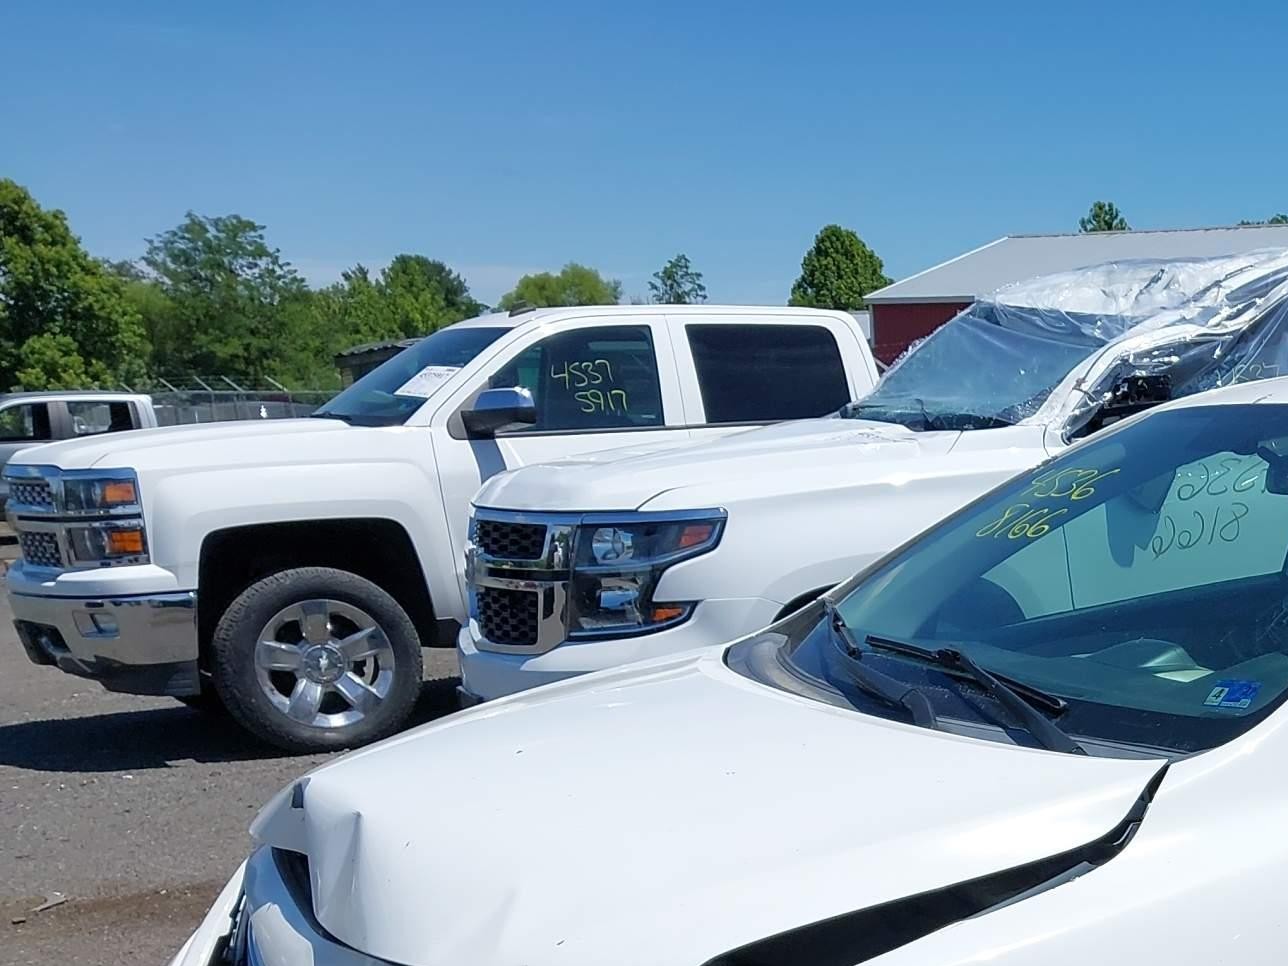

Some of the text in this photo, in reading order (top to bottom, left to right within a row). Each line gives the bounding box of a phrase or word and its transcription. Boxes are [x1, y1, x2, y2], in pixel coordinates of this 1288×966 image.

[550, 359, 614, 390] 4537
[574, 389, 628, 412] 5917
[1020, 467, 1121, 500] 4536
[976, 503, 1068, 539] 8166
